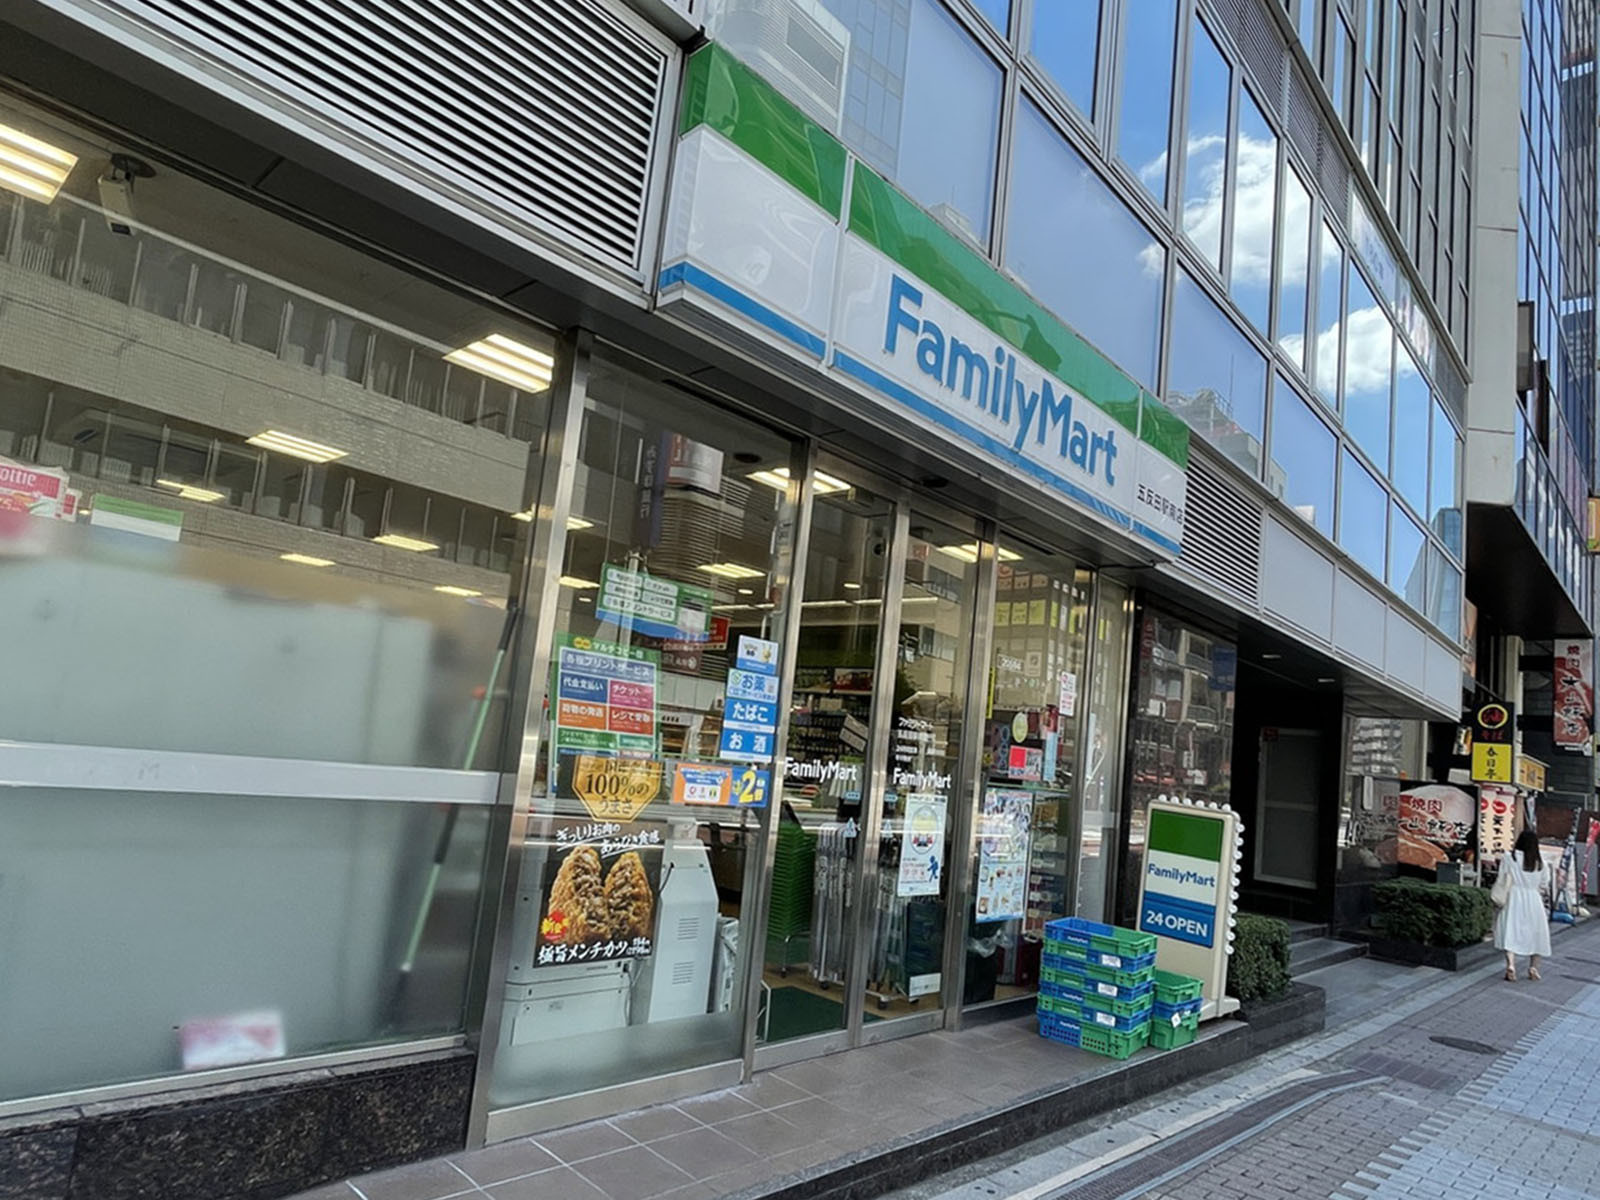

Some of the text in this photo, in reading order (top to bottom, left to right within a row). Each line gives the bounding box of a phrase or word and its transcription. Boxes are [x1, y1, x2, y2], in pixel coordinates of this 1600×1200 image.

[883, 273, 1117, 486] FamilyMart
[741, 674, 766, 692] お薬
[732, 702, 768, 722] たばこ
[729, 732, 767, 753] お酒
[783, 756, 857, 783] FamilyMart
[893, 767, 951, 790] FamilyMart
[584, 774, 650, 796] 100%の
[600, 796, 633, 814] うまさ
[1411, 796, 1443, 812] 焼肉
[556, 823, 621, 843] ぎっしりお肉の
[1148, 863, 1215, 887] FamilyMart
